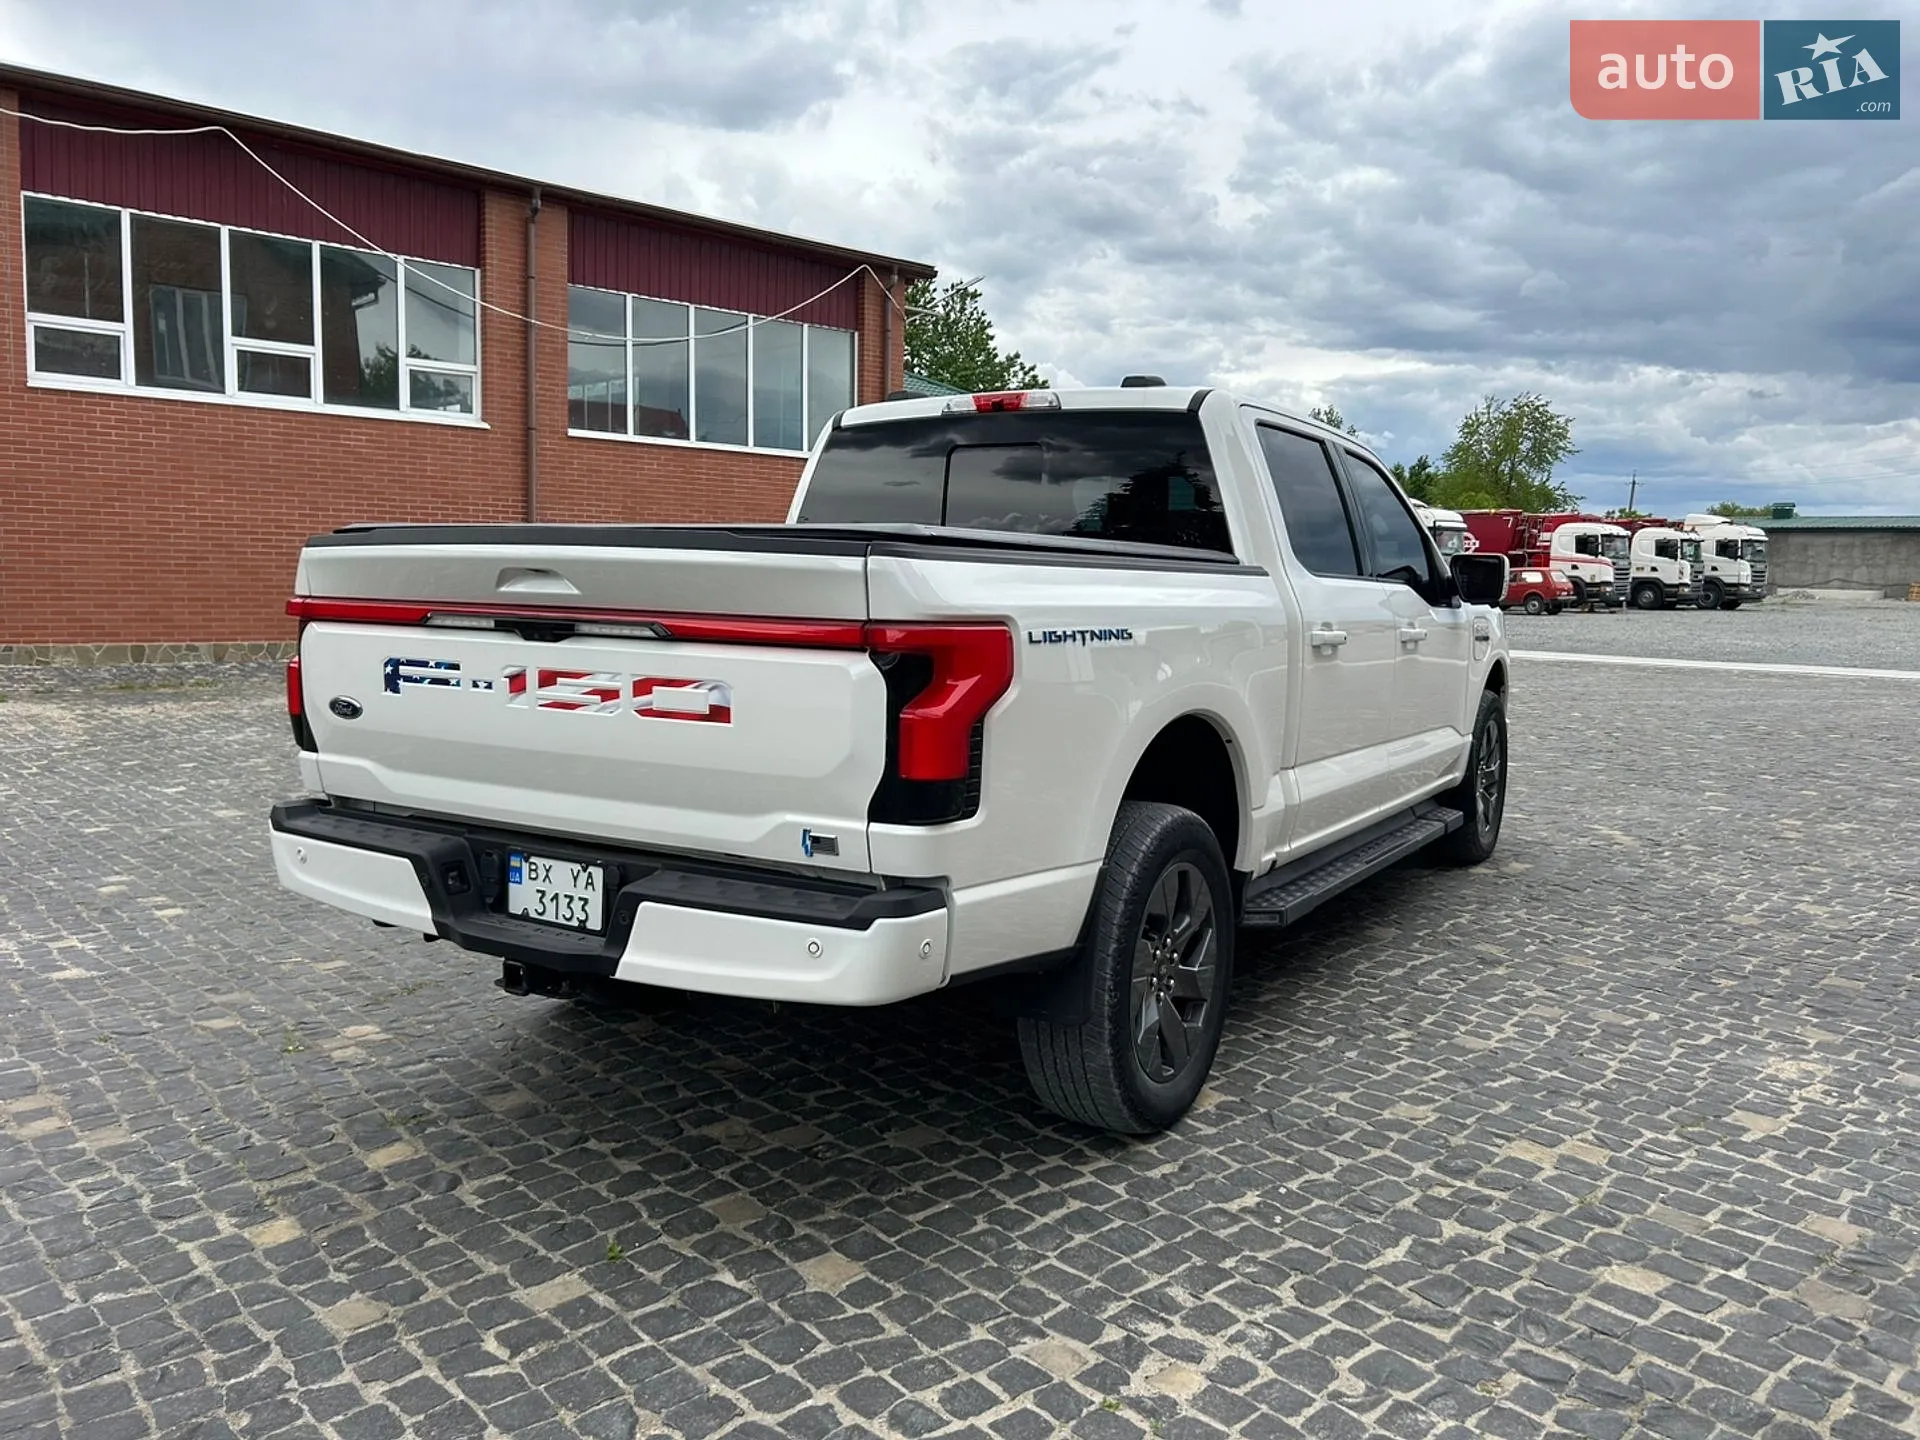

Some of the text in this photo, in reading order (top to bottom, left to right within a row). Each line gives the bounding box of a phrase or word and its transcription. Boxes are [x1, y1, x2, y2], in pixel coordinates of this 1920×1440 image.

[1028, 629, 1133, 646] LIGHTNING
[382, 656, 733, 727] F-150
[528, 861, 595, 891] BX YA
[534, 888, 589, 924] 3133
